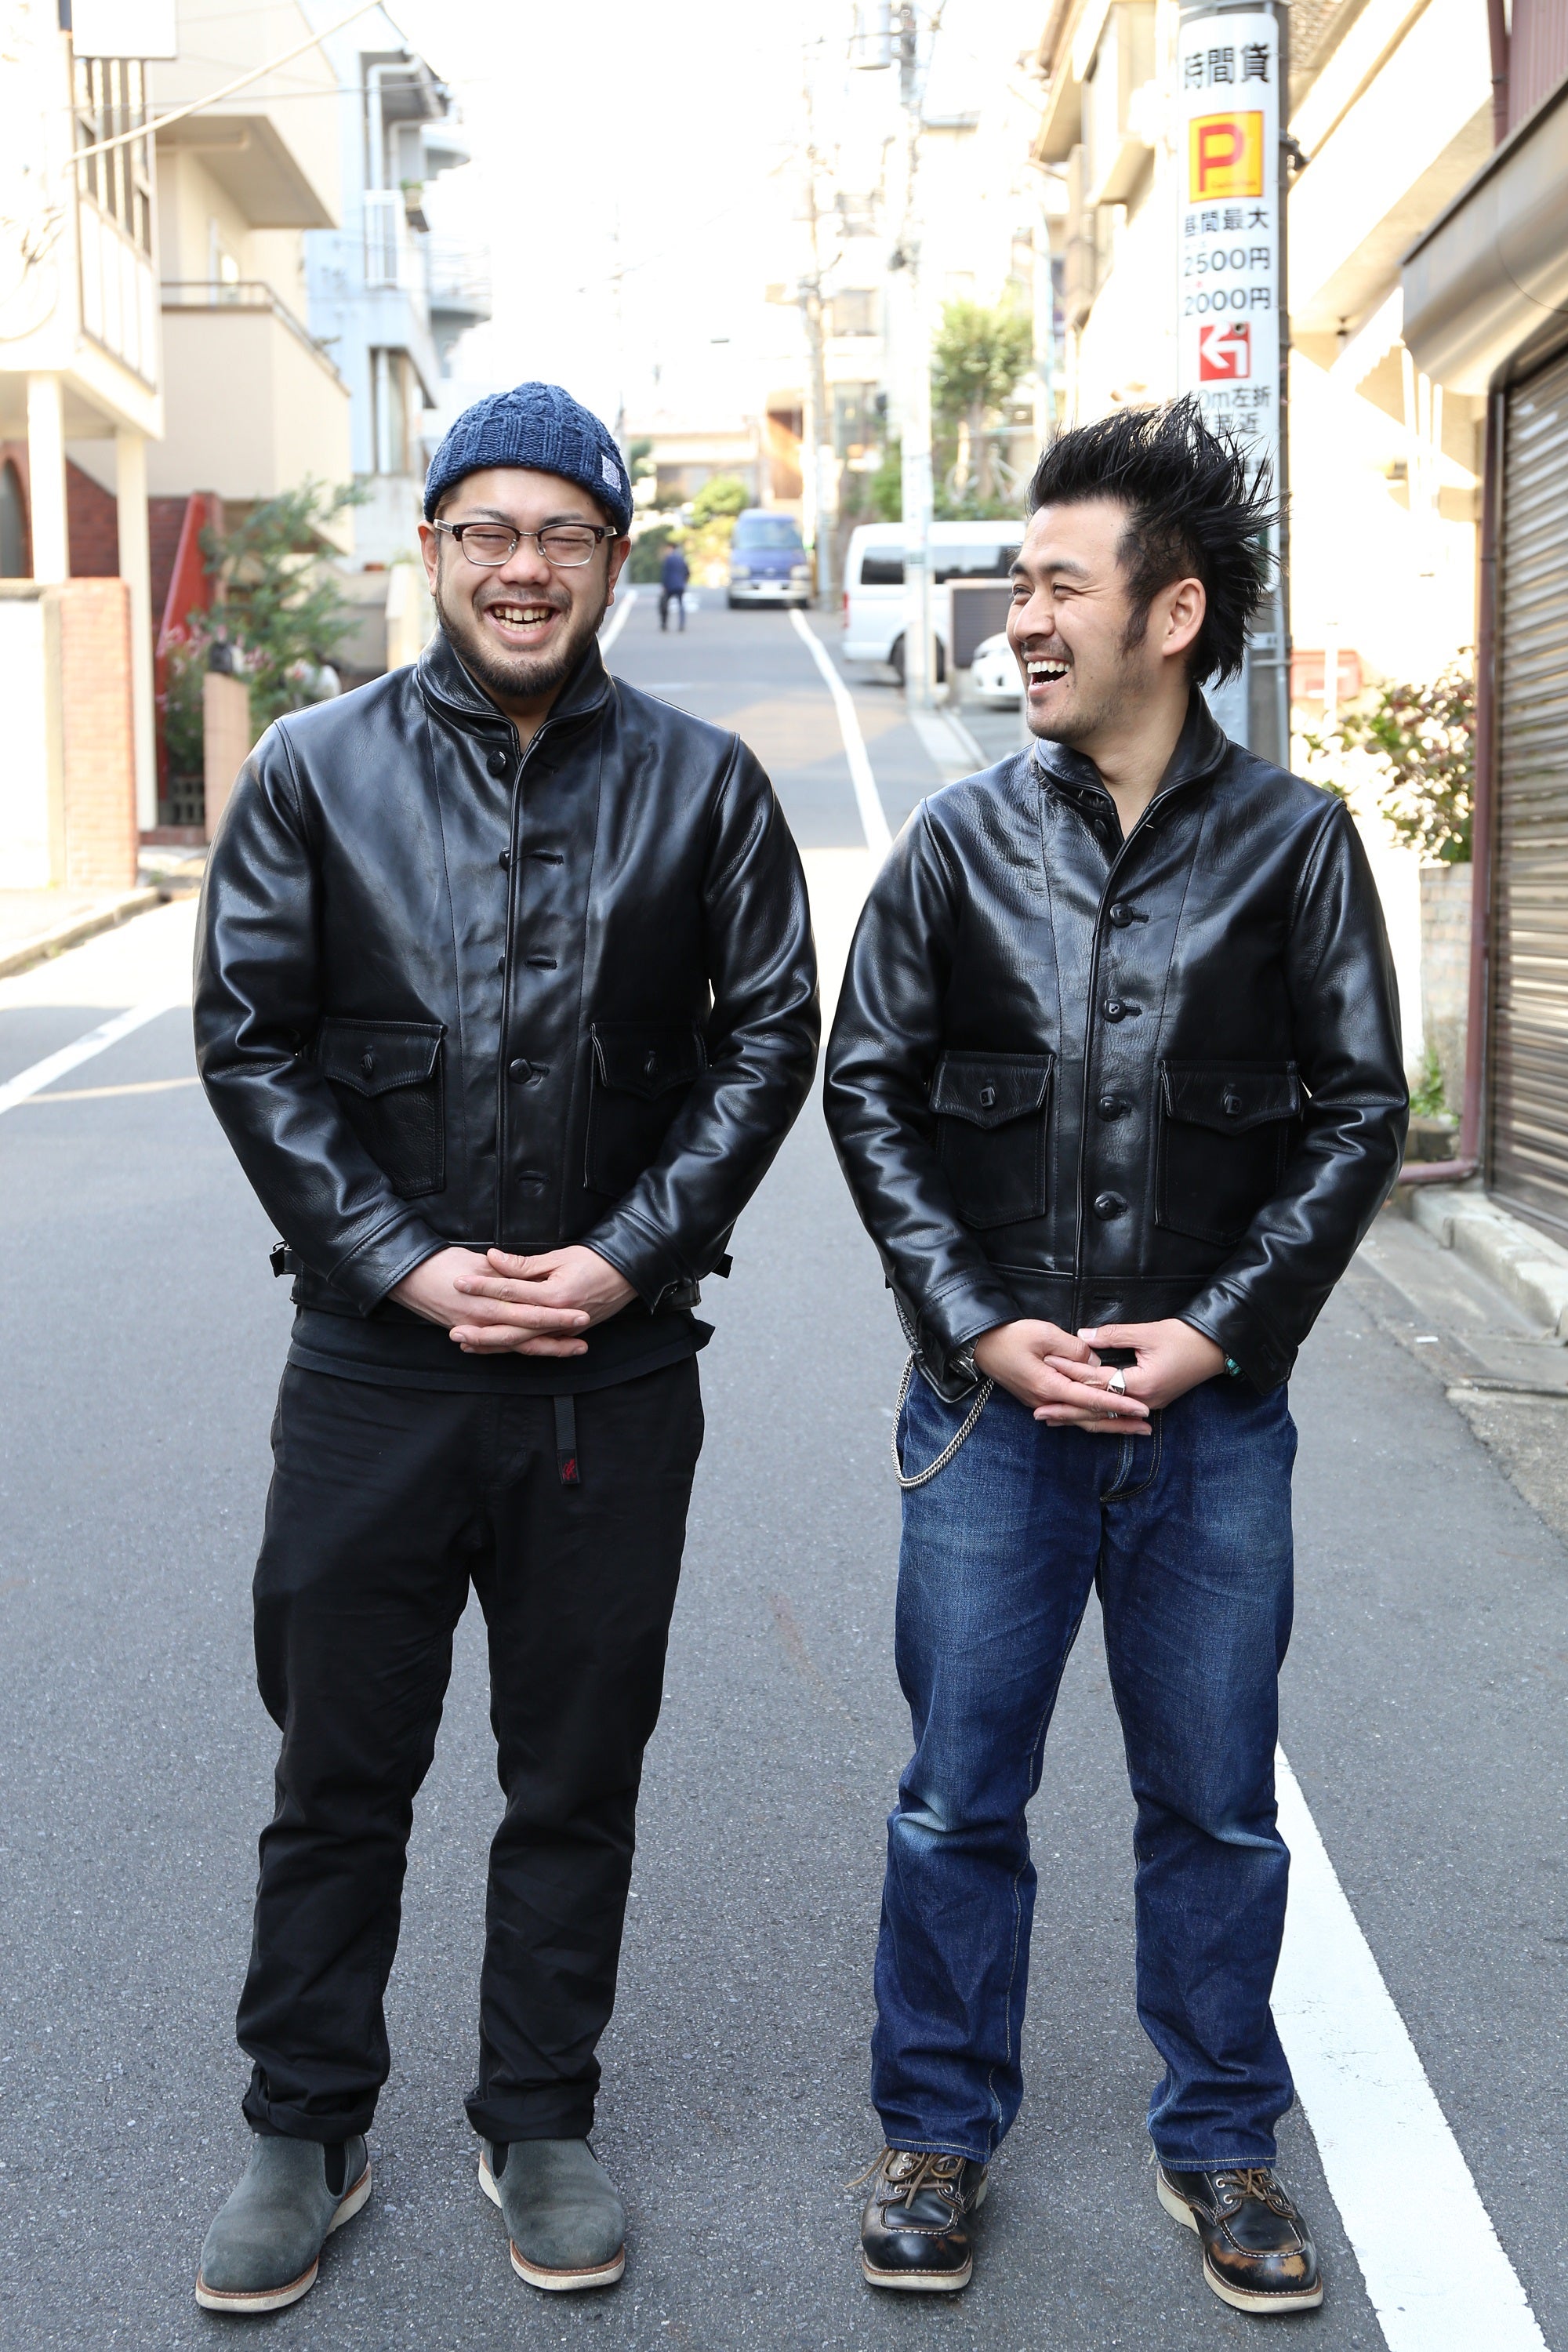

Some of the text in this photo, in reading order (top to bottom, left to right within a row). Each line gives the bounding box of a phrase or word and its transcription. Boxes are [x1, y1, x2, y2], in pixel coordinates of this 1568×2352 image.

[1185, 42, 1271, 89] 時間貸
[1199, 123, 1244, 192] P
[1185, 207, 1269, 238] 昼間最大
[1185, 246, 1271, 277] 2500円
[1185, 287, 1272, 316] 2000円
